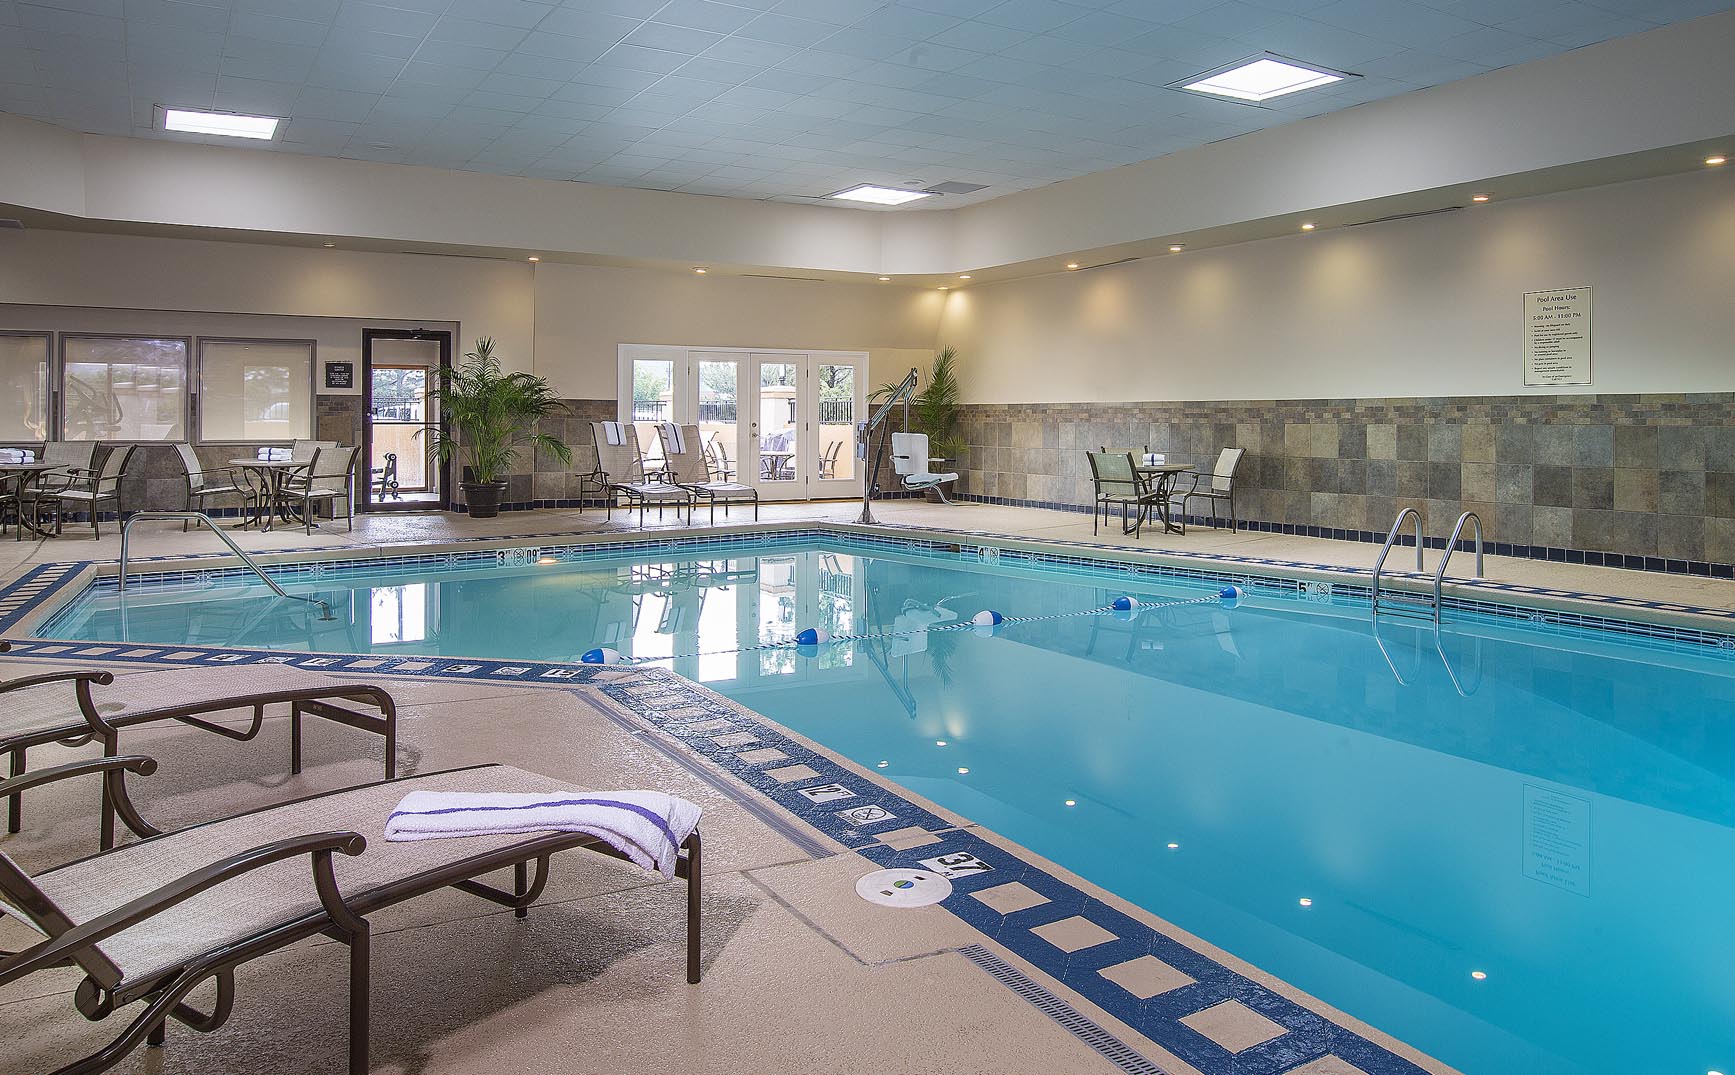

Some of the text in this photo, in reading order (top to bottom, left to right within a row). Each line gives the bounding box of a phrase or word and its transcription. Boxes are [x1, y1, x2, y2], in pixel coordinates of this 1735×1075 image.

[498, 551, 505, 560] 3
[979, 548, 984, 556] 4
[1299, 582, 1306, 592] 5
[805, 785, 842, 796] 12
